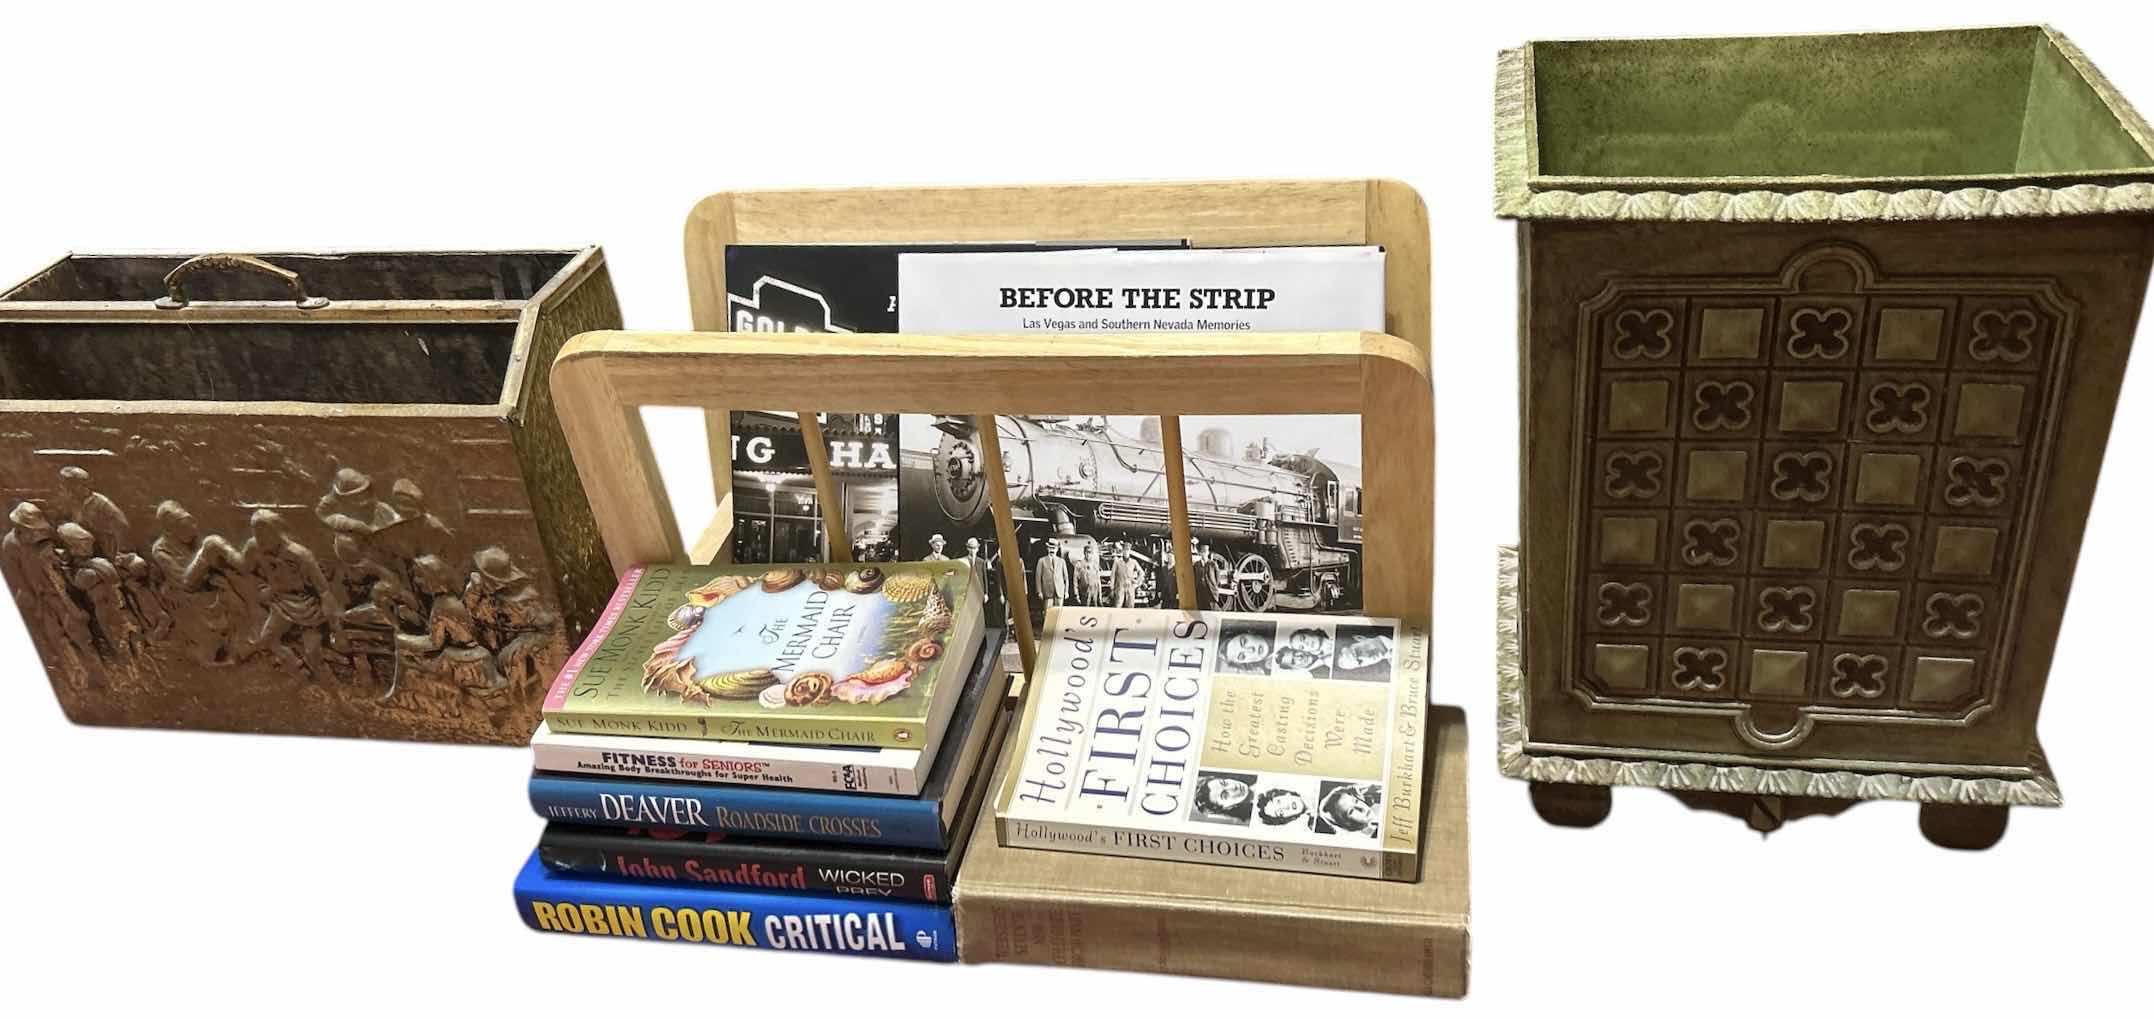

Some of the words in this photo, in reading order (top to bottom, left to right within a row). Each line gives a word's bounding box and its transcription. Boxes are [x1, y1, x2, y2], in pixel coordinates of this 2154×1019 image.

[999, 287, 1113, 309] BEFORE
[1122, 288, 1181, 309] THE
[1189, 288, 1276, 310] STRIP
[1023, 318, 1041, 330] Las
[1043, 318, 1076, 332] Vegas
[1078, 319, 1098, 330] and
[1101, 319, 1150, 331] Southern
[1153, 319, 1194, 331] Nevada
[1196, 320, 1251, 332] Memories
[829, 440, 897, 469] HA
[632, 567, 672, 609] KIDD
[592, 614, 648, 661] MONK
[769, 591, 829, 672] MERMAID
[812, 604, 856, 659] CHAIR
[574, 661, 613, 698] SUE
[1400, 677, 1420, 718] Bruce
[1019, 615, 1098, 804] Hollywood's
[1080, 627, 1159, 803] FIRST
[1141, 620, 1208, 815] CHOICES
[1219, 689, 1237, 713] the
[592, 719, 641, 731] MONK
[648, 720, 688, 732] KIDD
[756, 725, 825, 740] MERMAID
[828, 728, 875, 743] CHAIR
[1211, 718, 1233, 752] How
[1238, 691, 1264, 759] Greatest
[1267, 696, 1295, 757] Casting
[1294, 689, 1321, 766] Decisions
[1324, 707, 1346, 751] Were
[1352, 708, 1376, 754] Made
[1399, 722, 1416, 737] &
[577, 761, 616, 772] Amazing
[619, 764, 640, 774] Body
[645, 766, 712, 779] Breakthroughs
[715, 769, 728, 779] for
[732, 771, 754, 783] Super
[762, 773, 793, 783] Health
[602, 752, 677, 768] FITNESS
[679, 757, 698, 770] for
[1392, 739, 1416, 810] Burkhart
[600, 793, 710, 828] DEAVER
[716, 806, 800, 833] ROADSIDE
[809, 815, 881, 838] CROSSES
[1390, 815, 1414, 845] Jeff
[1016, 822, 1106, 844] Hollywood's
[1113, 831, 1176, 850] FIRST
[1184, 837, 1286, 862] CHOICES
[616, 855, 678, 880] John
[684, 859, 806, 890] Sandford
[818, 868, 905, 887] WICKED
[532, 901, 648, 938] ROBIN
[650, 907, 757, 946] COOK
[764, 912, 906, 951] CRITICAL
